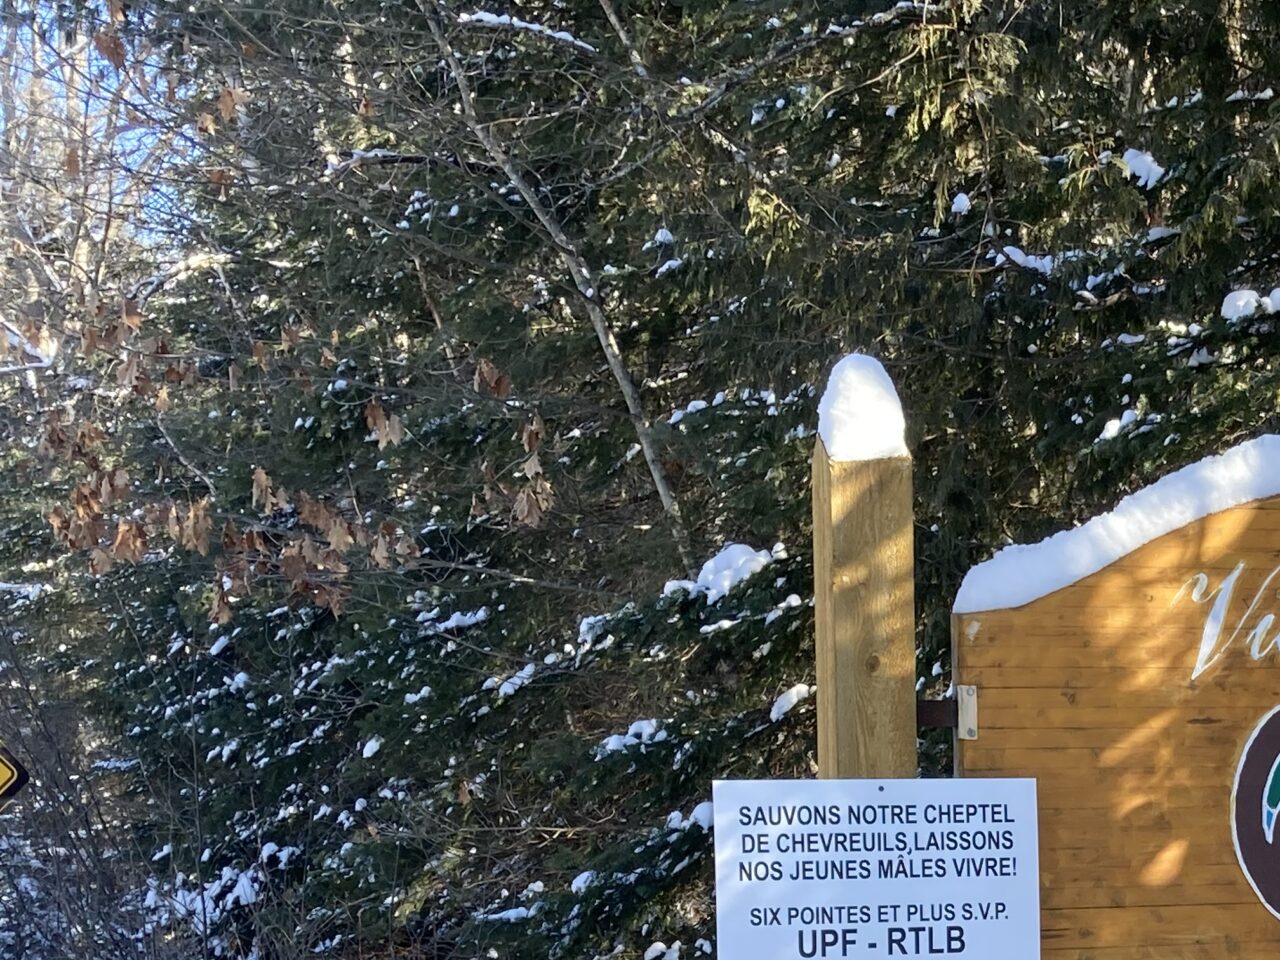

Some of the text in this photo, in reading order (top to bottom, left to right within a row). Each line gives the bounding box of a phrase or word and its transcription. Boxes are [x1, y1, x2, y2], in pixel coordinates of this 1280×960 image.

[739, 804, 1015, 825] SAUVONS NOTRE CHEPTEL
[741, 834, 769, 853] DE
[739, 855, 1017, 881] NOS JEUNES MÂLES VIVRE!
[750, 903, 1009, 926] SIX POINTES ET PLUS S.V.P.
[798, 929, 858, 958] UPF
[887, 926, 966, 955] RTLB
